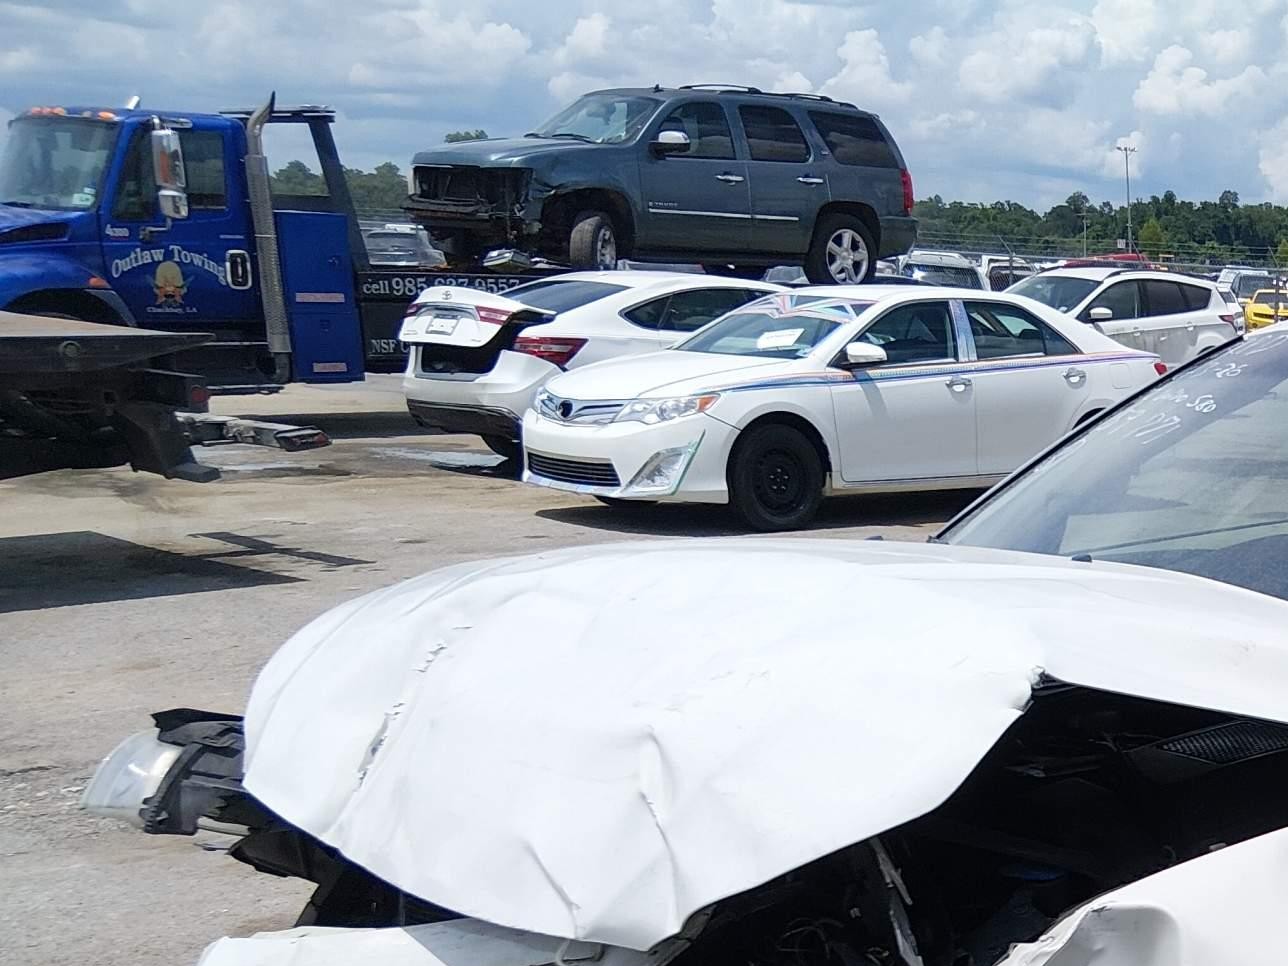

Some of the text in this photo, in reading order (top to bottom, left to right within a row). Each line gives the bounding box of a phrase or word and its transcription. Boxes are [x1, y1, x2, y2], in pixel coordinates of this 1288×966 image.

[111, 245, 228, 286] Outlaw Towing
[362, 280, 390, 294] cell
[371, 339, 397, 353] NSF
